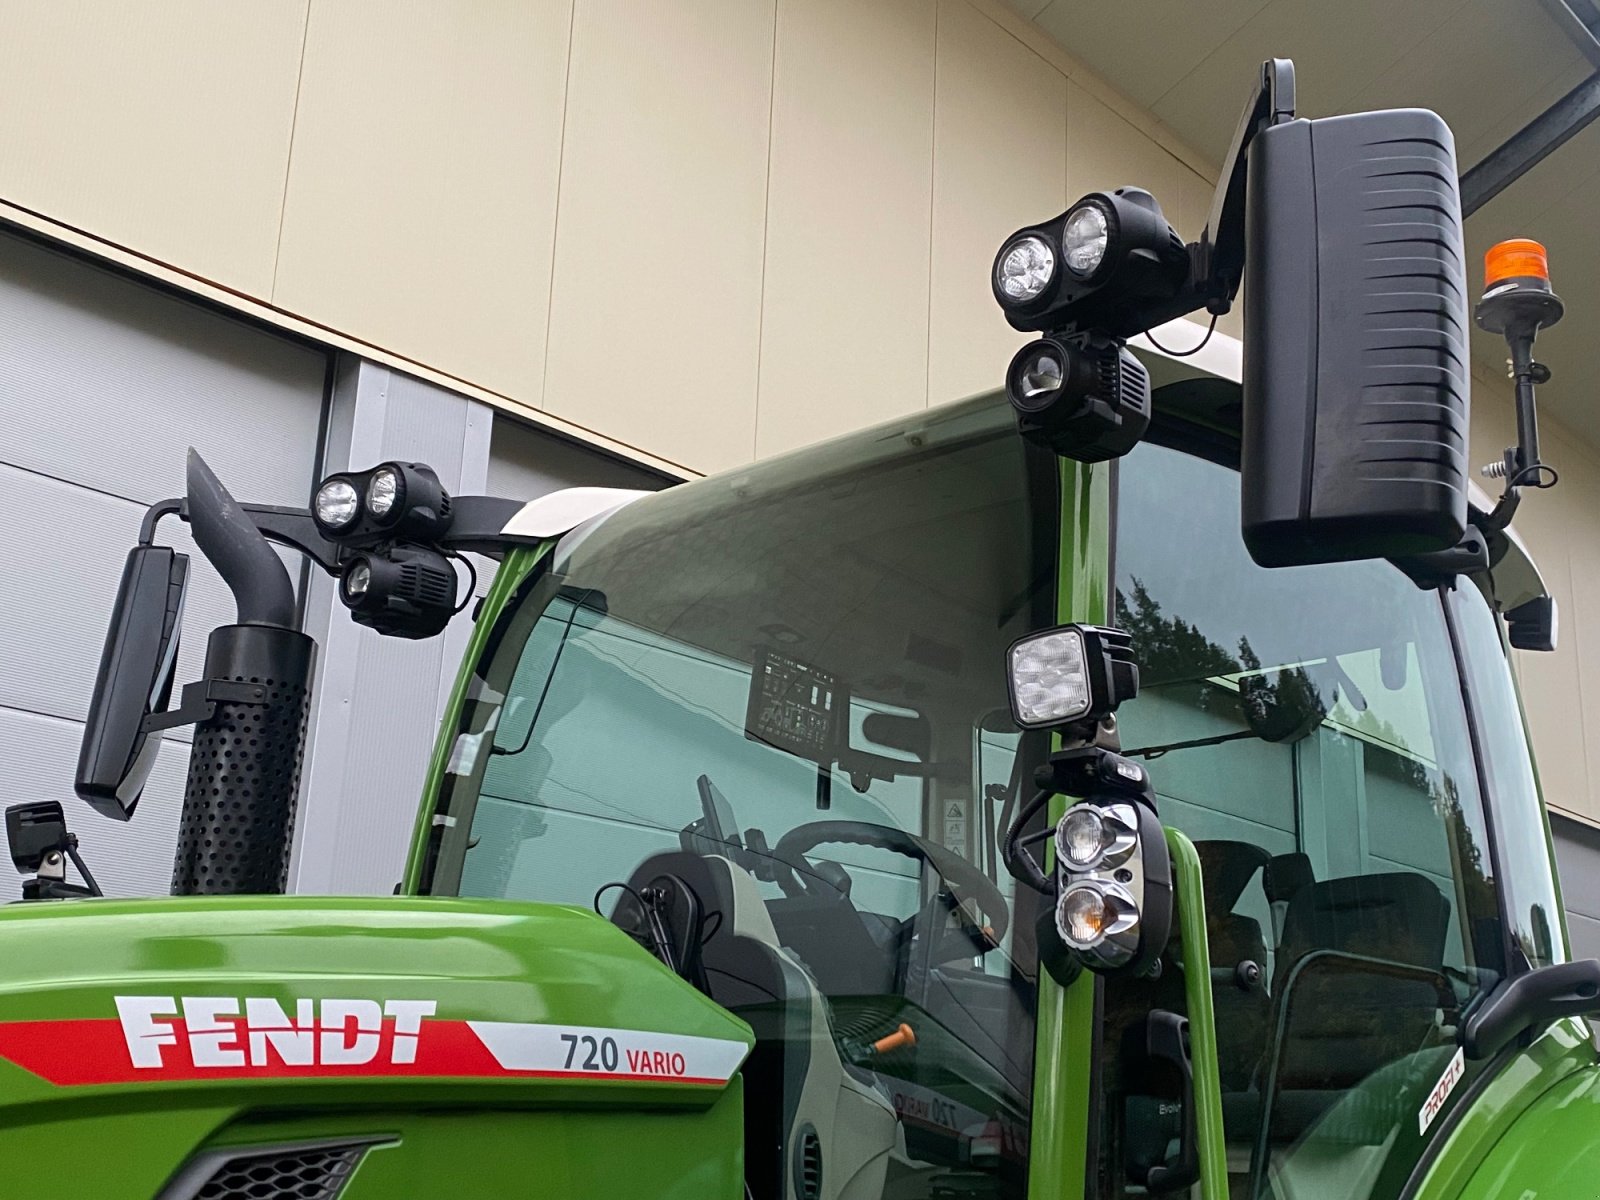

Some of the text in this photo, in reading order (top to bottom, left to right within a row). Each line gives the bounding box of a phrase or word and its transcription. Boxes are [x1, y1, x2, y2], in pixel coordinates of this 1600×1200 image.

[114, 996, 437, 1069] FENDT
[560, 1033, 686, 1075] 720 VARIO
